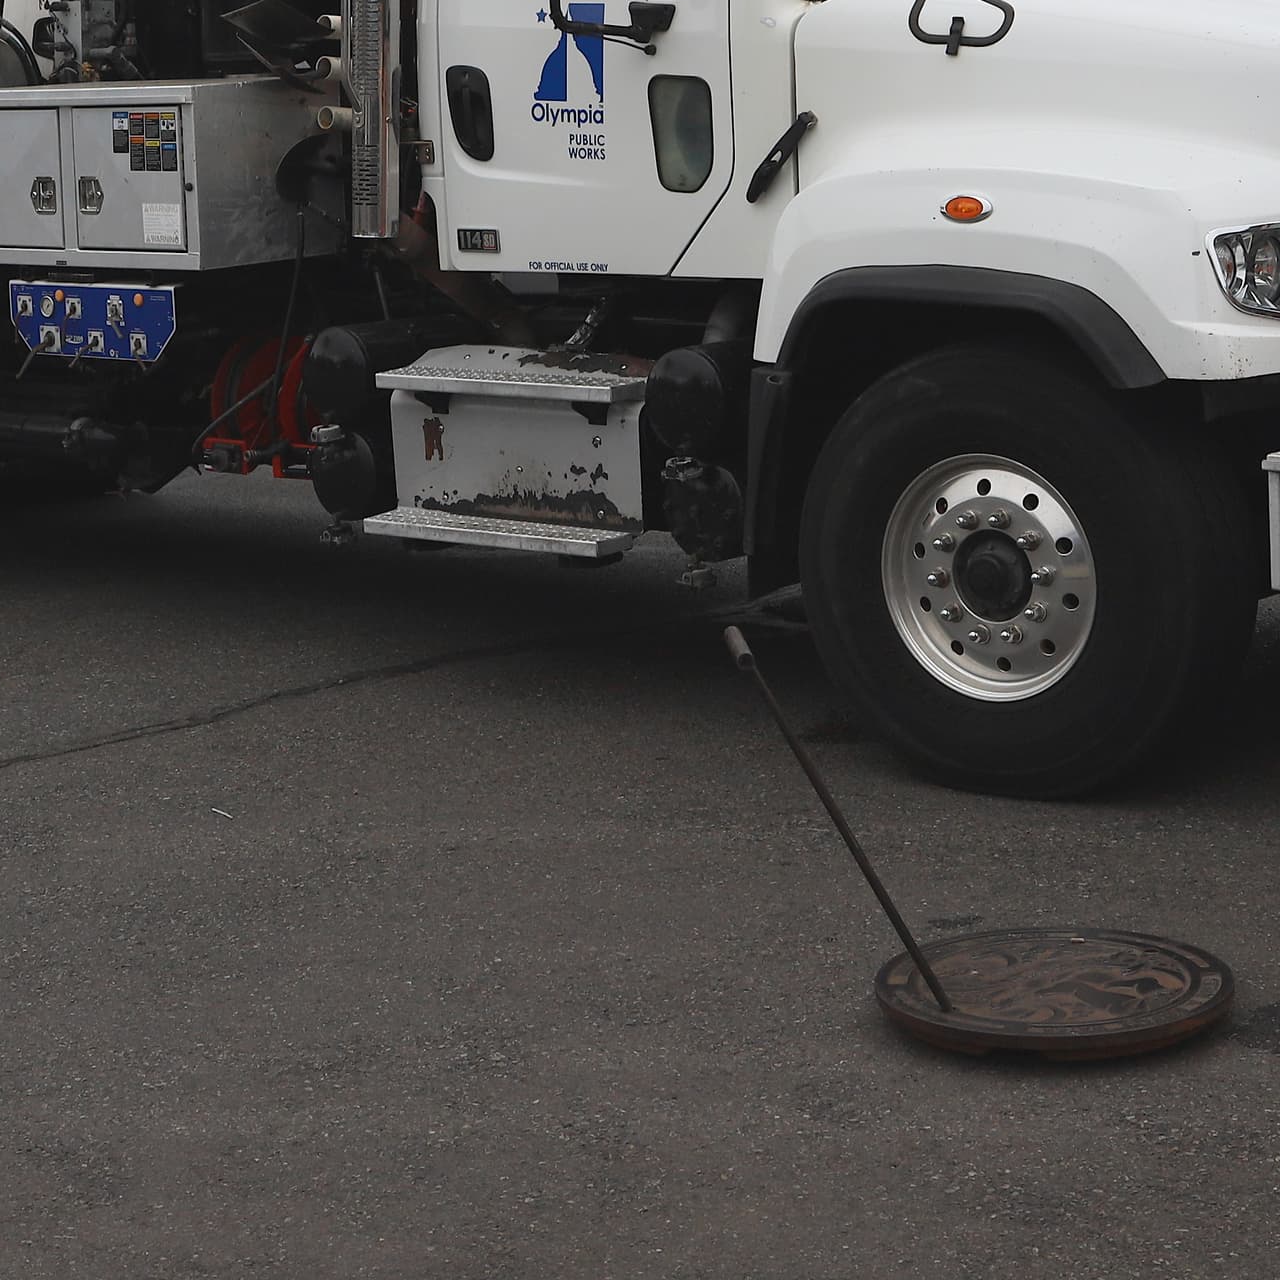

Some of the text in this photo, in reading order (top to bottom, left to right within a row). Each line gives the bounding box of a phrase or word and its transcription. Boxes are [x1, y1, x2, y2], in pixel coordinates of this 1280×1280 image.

[531, 103, 604, 128] Olympia
[569, 134, 606, 146] PUBLIC
[568, 147, 606, 160] WORKS
[529, 261, 609, 272] FOR OFFICIAL USE ONLY
